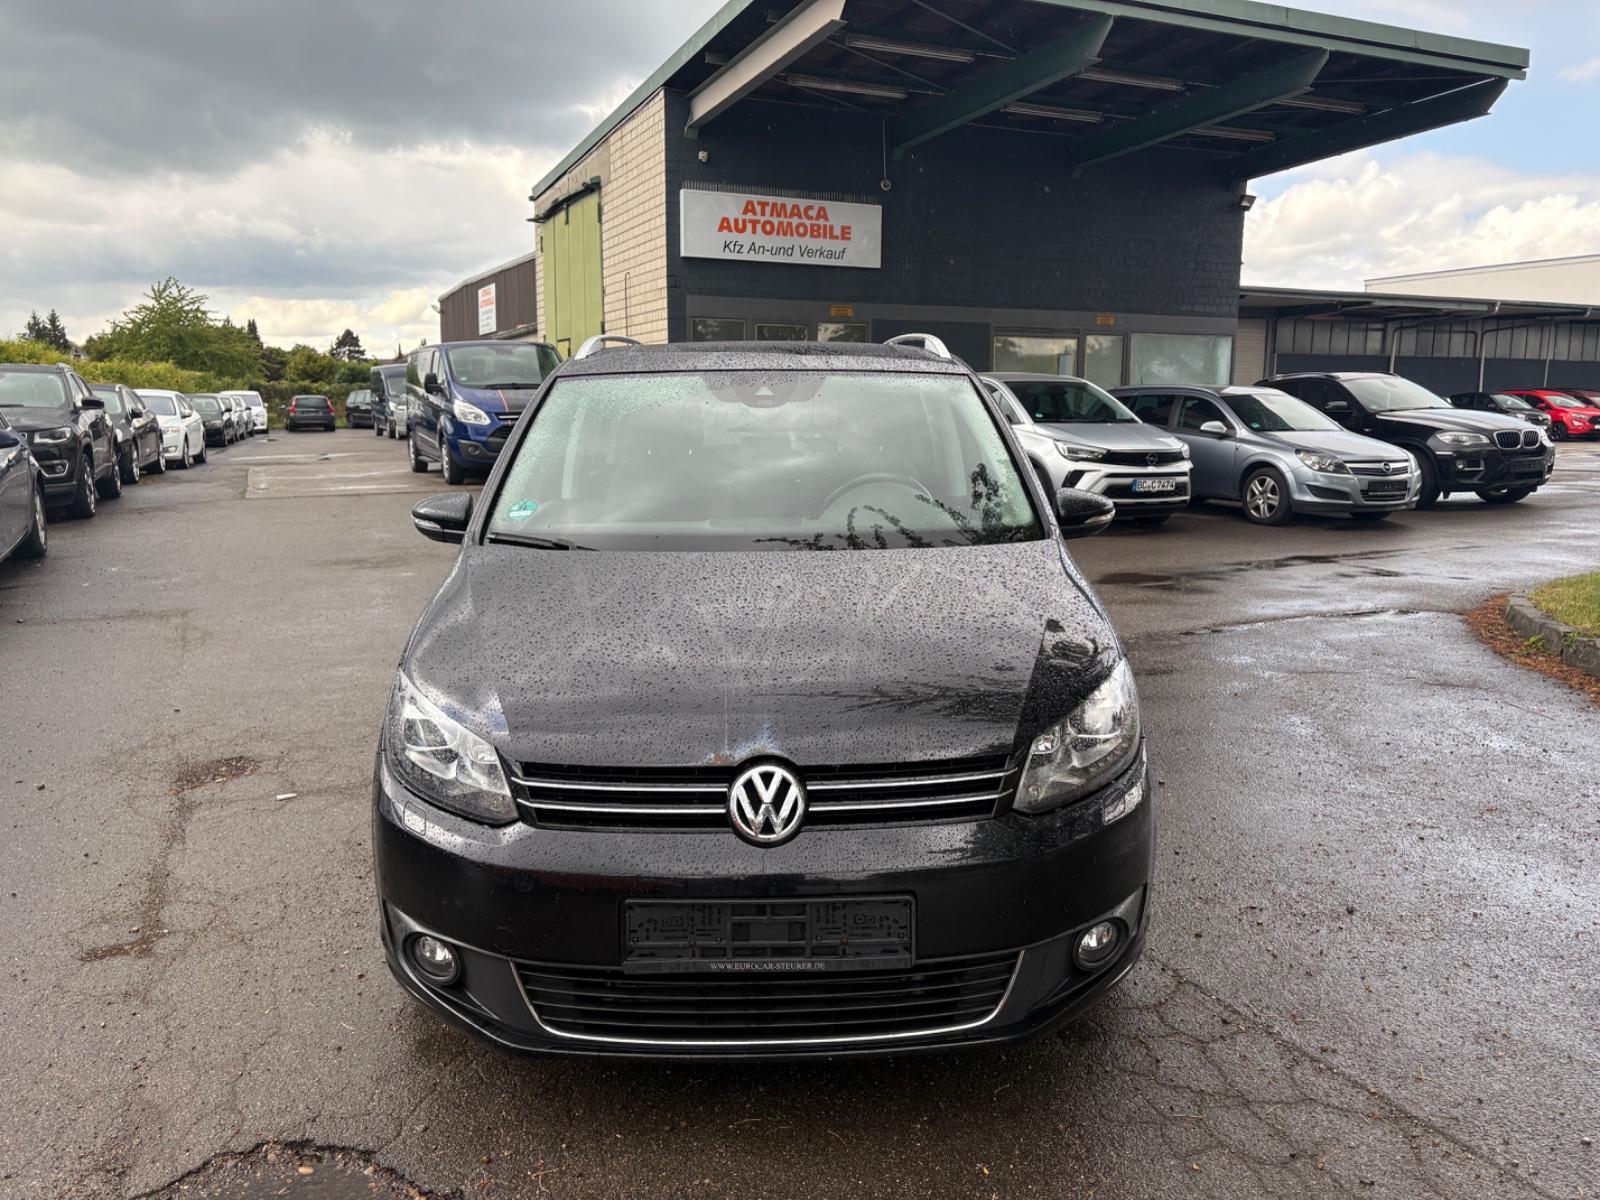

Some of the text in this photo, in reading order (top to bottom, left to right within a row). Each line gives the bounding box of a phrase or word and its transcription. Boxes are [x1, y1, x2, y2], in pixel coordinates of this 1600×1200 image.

[742, 200, 829, 222] ATMACA
[717, 216, 852, 241] AUTOMOBILE
[723, 240, 847, 260] Kfz An-und Verkauf
